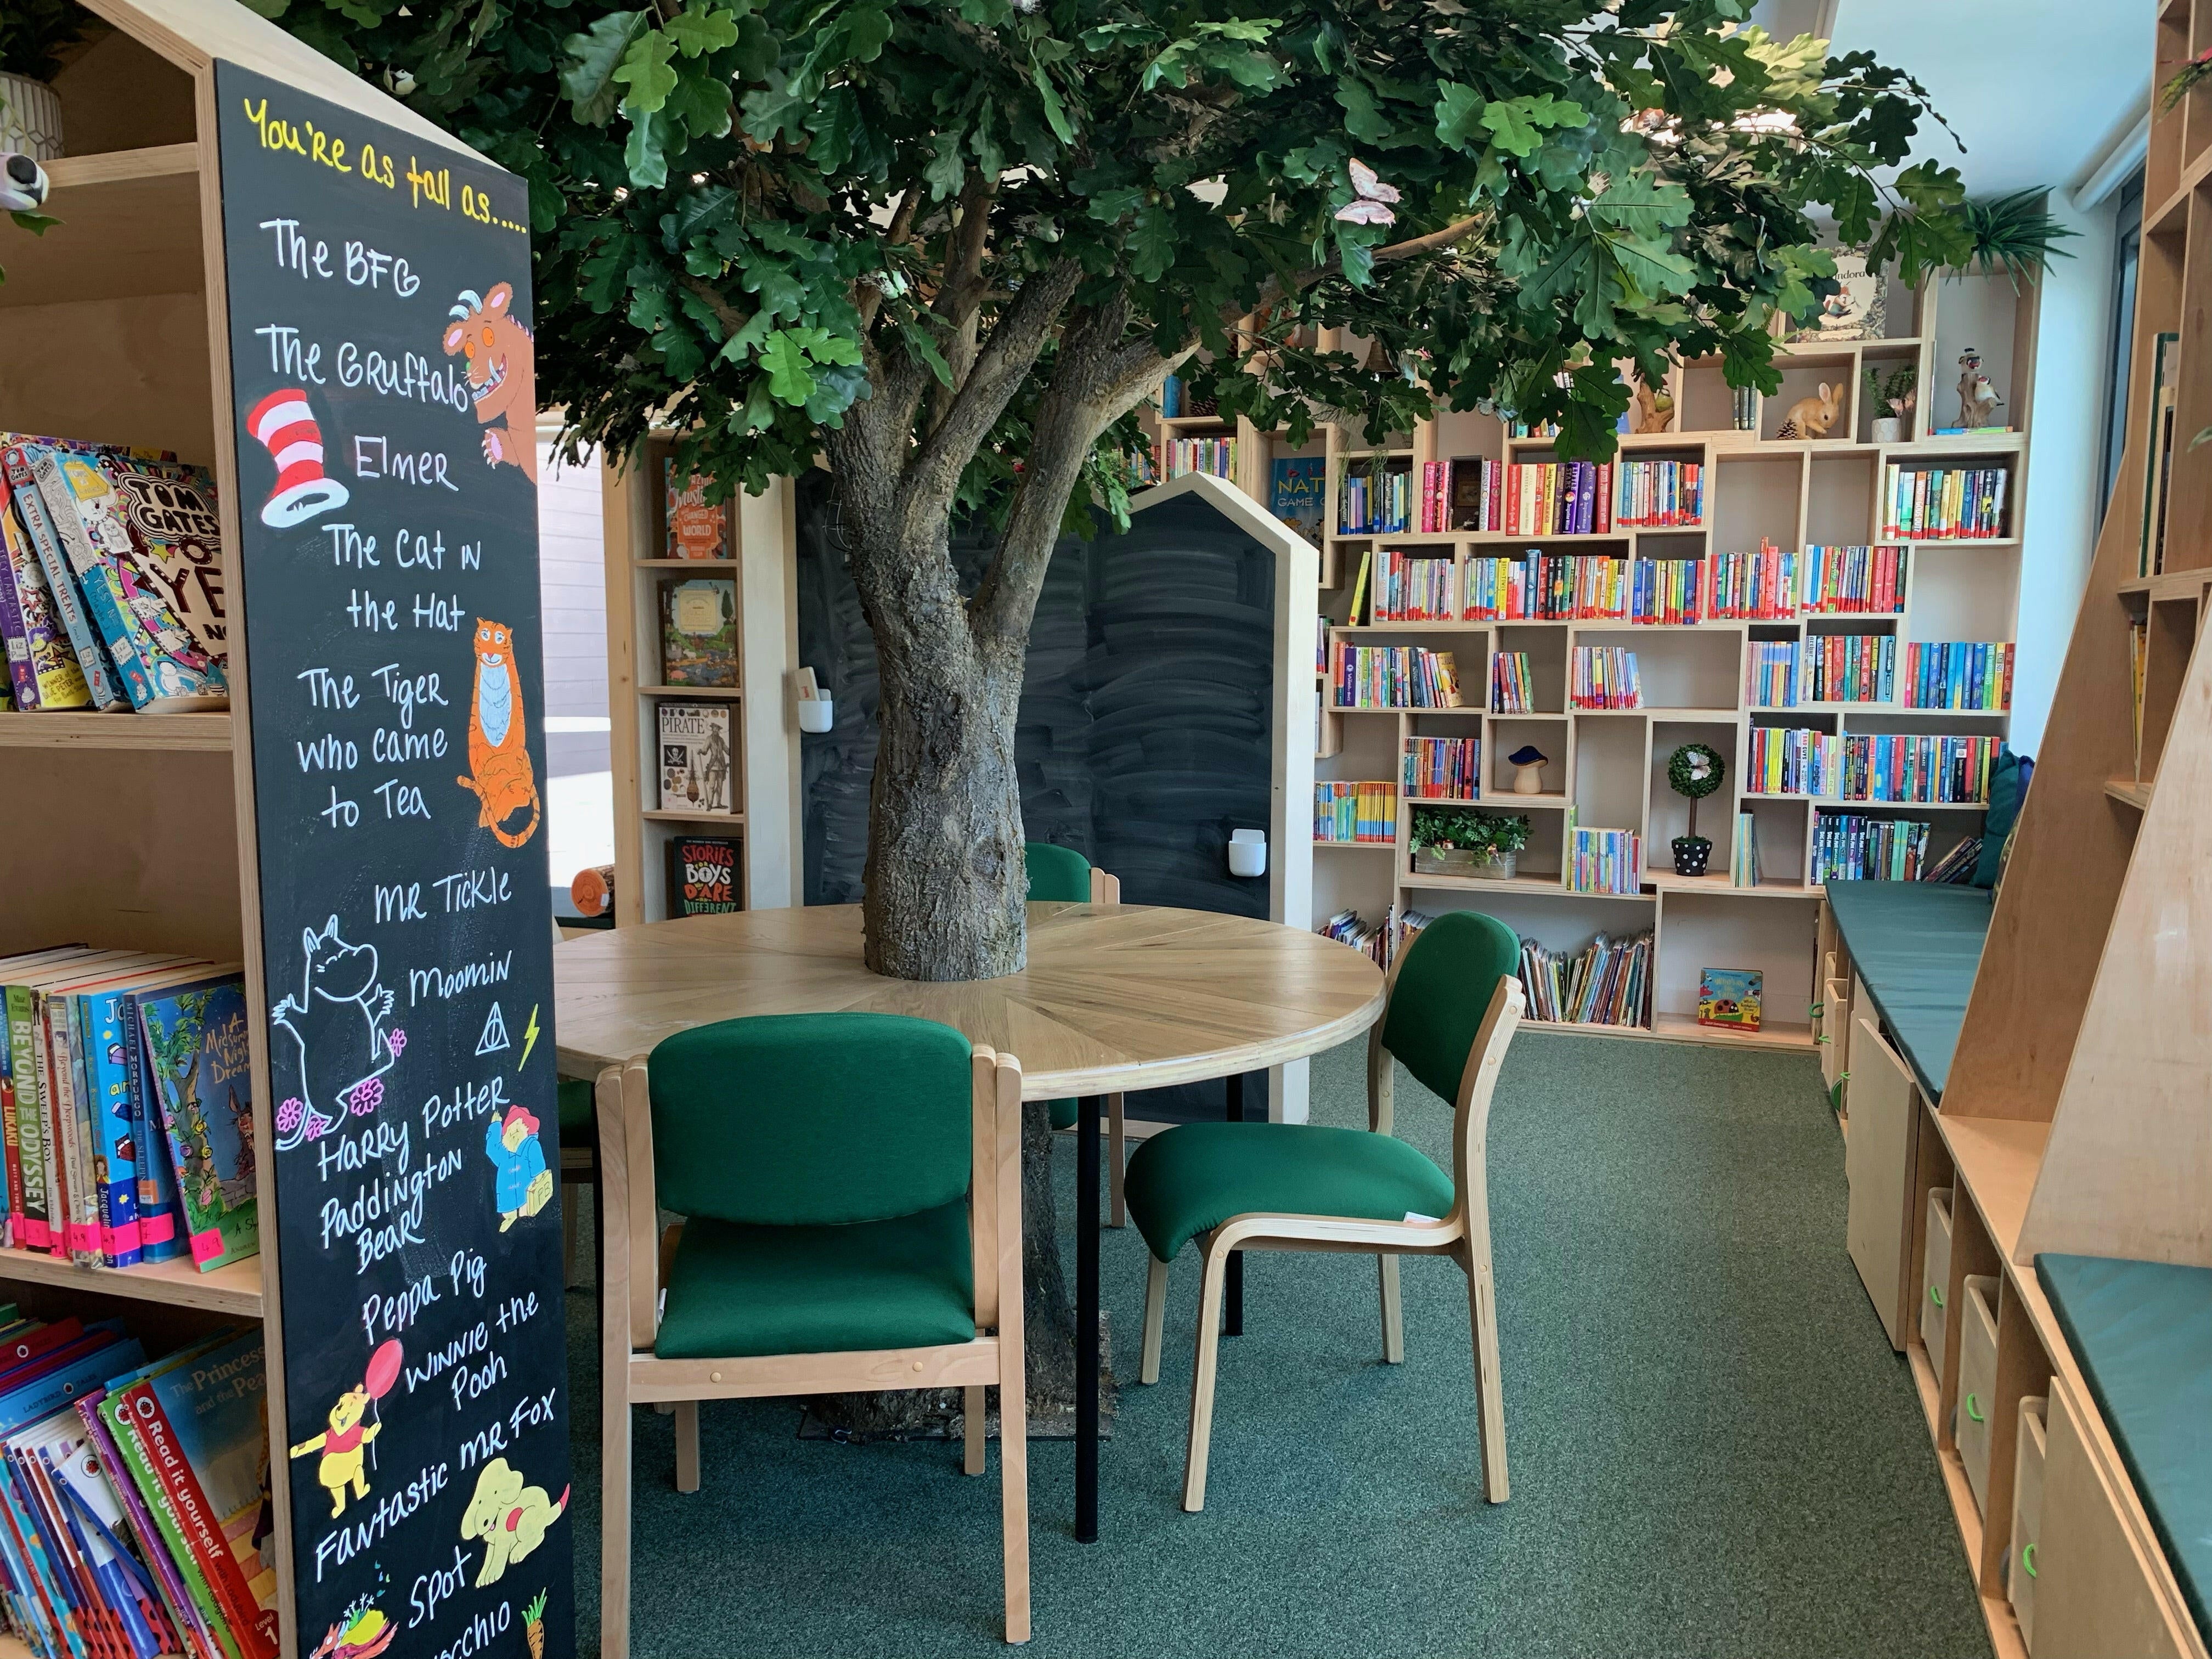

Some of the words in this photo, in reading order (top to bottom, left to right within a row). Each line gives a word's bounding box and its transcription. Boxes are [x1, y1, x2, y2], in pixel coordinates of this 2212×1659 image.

[362, 144, 394, 189] as
[407, 155, 450, 208] tall
[259, 218, 333, 279] The
[345, 240, 420, 297] BFG
[255, 323, 326, 385] The
[11, 471, 27, 481] GATES
[37, 461, 48, 473] TOM
[40, 464, 53, 479] GATES
[128, 480, 204, 512] TOM
[1277, 497, 1314, 506] GAME
[139, 507, 221, 537] GATES
[682, 524, 712, 536] WORLD
[1914, 518, 1922, 532] OUT?
[22, 493, 44, 531] EXTRA
[38, 533, 59, 579] SPECIAL
[57, 581, 77, 622] TREATS
[321, 523, 380, 569] The
[397, 528, 445, 570] Cat
[347, 589, 398, 632] the
[413, 592, 466, 631] Hat
[12, 640, 24, 651] Liz
[115, 642, 127, 654] Liz
[43, 674, 65, 690] WINNER
[55, 679, 75, 696] PETER
[297, 667, 360, 709] The
[662, 717, 705, 734] PIRATE
[297, 733, 359, 772] who
[373, 727, 448, 763] came
[321, 785, 359, 828] to
[374, 778, 431, 820] Tea
[681, 844, 735, 867] STORIES
[432, 866, 512, 913] Tickle
[685, 863, 732, 888] BOYS
[684, 882, 734, 902] DARE
[684, 899, 737, 915] DIFFERENT
[126, 1002, 136, 1052] MICHAEL
[229, 1012, 244, 1032] A
[12, 1021, 37, 1105] BEYOND
[36, 1054, 45, 1079] THE
[57, 1052, 68, 1085] Beyond
[63, 1086, 71, 1099] the
[129, 1055, 142, 1118] MORPURGO
[38, 1081, 51, 1137] SWEEP'S
[4, 1106, 19, 1147] LUKAKU
[62, 1101, 76, 1148] Deepwoods
[42, 1138, 52, 1164] BOY
[20, 1126, 46, 1213] ODYSSEY
[537, 1182, 551, 1206] PB
[362, 1275, 441, 1346] Peppa
[450, 1248, 487, 1299] Pig
[495, 1291, 539, 1333] the
[170, 1381, 194, 1397] The
[451, 1351, 507, 1411] Pooh
[22, 1390, 62, 1414] LADYBIRD
[195, 1396, 216, 1415] and
[217, 1388, 234, 1403] the
[509, 1387, 556, 1438] Fox
[148, 1420, 179, 1469] Read
[171, 1469, 186, 1487] it
[177, 1488, 224, 1559] yourself
[408, 1544, 472, 1629] Spot
[255, 1613, 274, 1631] Level
[264, 1626, 278, 1645] 1
